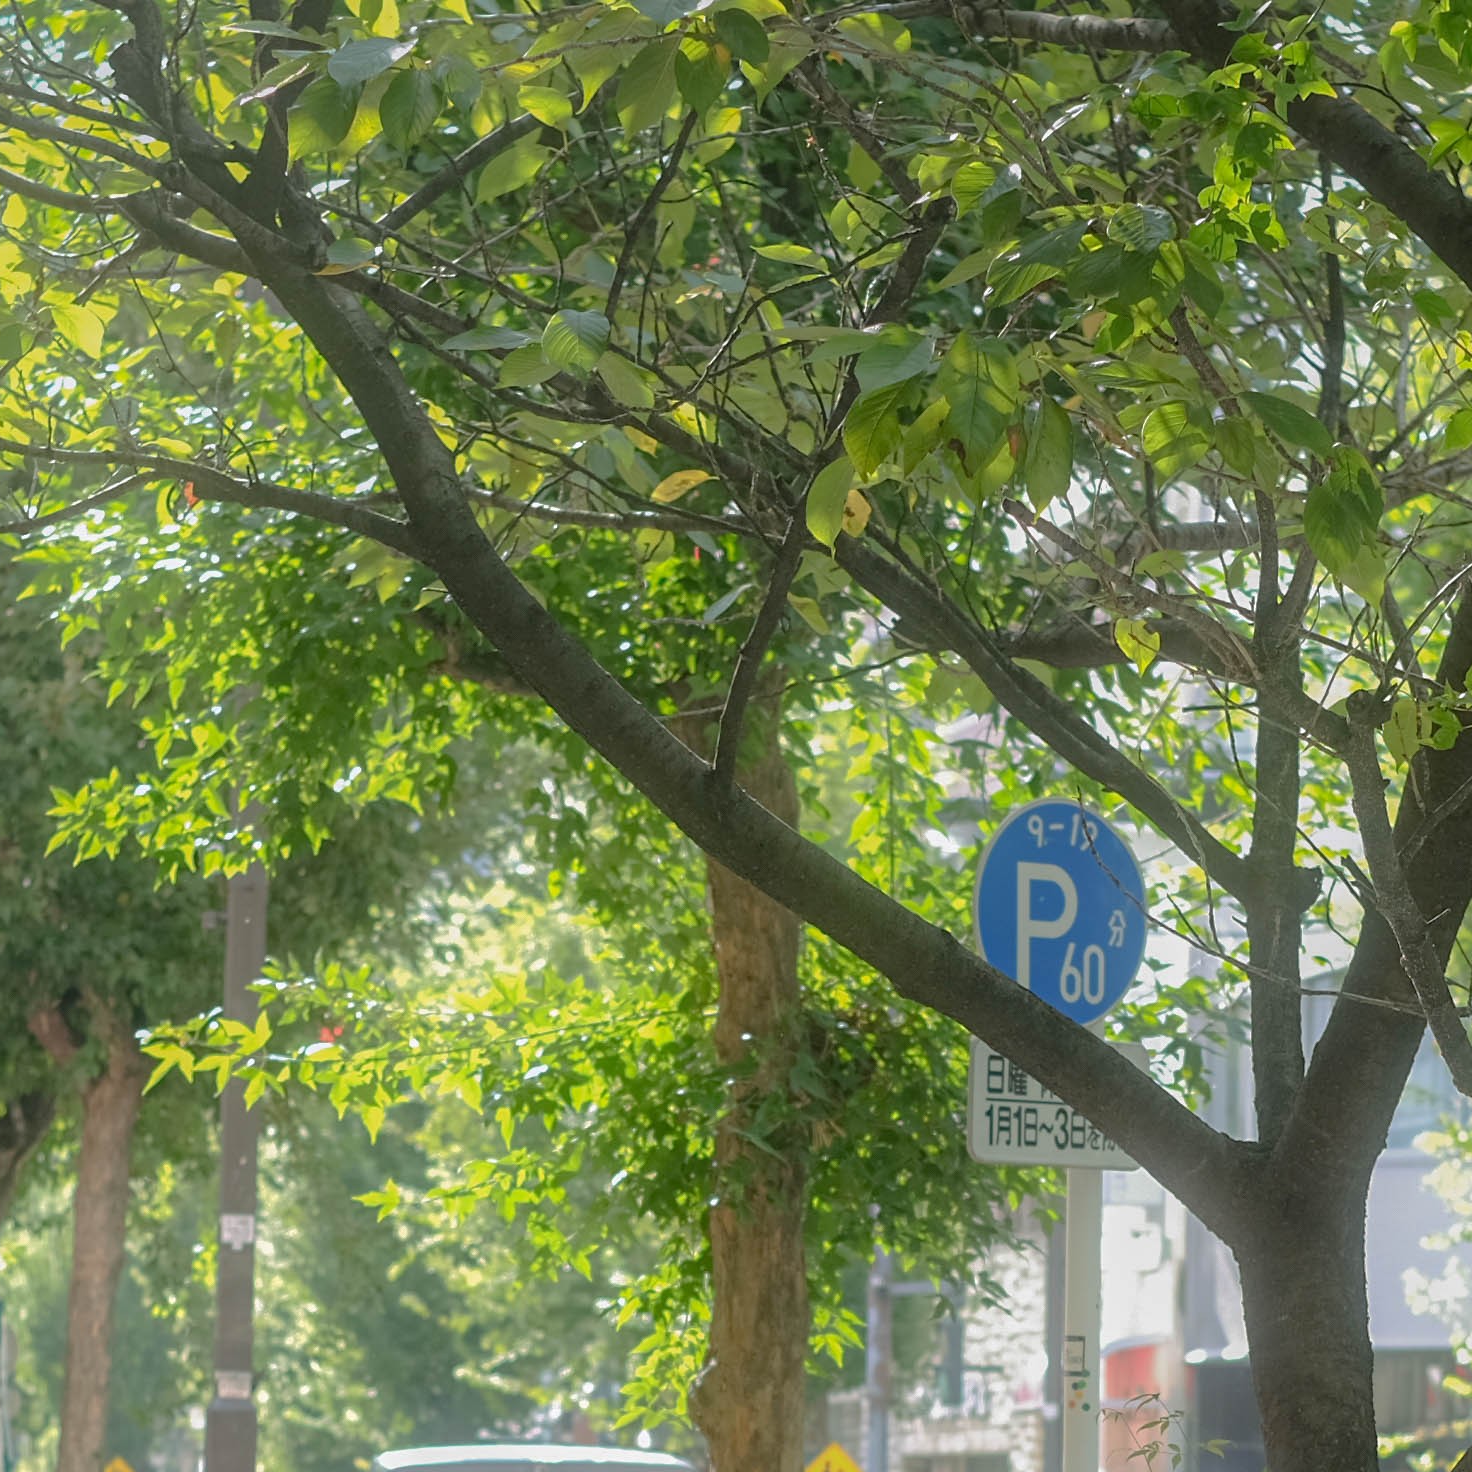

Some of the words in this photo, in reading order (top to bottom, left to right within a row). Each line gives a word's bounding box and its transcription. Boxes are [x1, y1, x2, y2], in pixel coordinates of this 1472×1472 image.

[1028, 815, 1099, 851] 9-19
[1016, 861, 1078, 992] P
[1059, 944, 1106, 1004] 60
